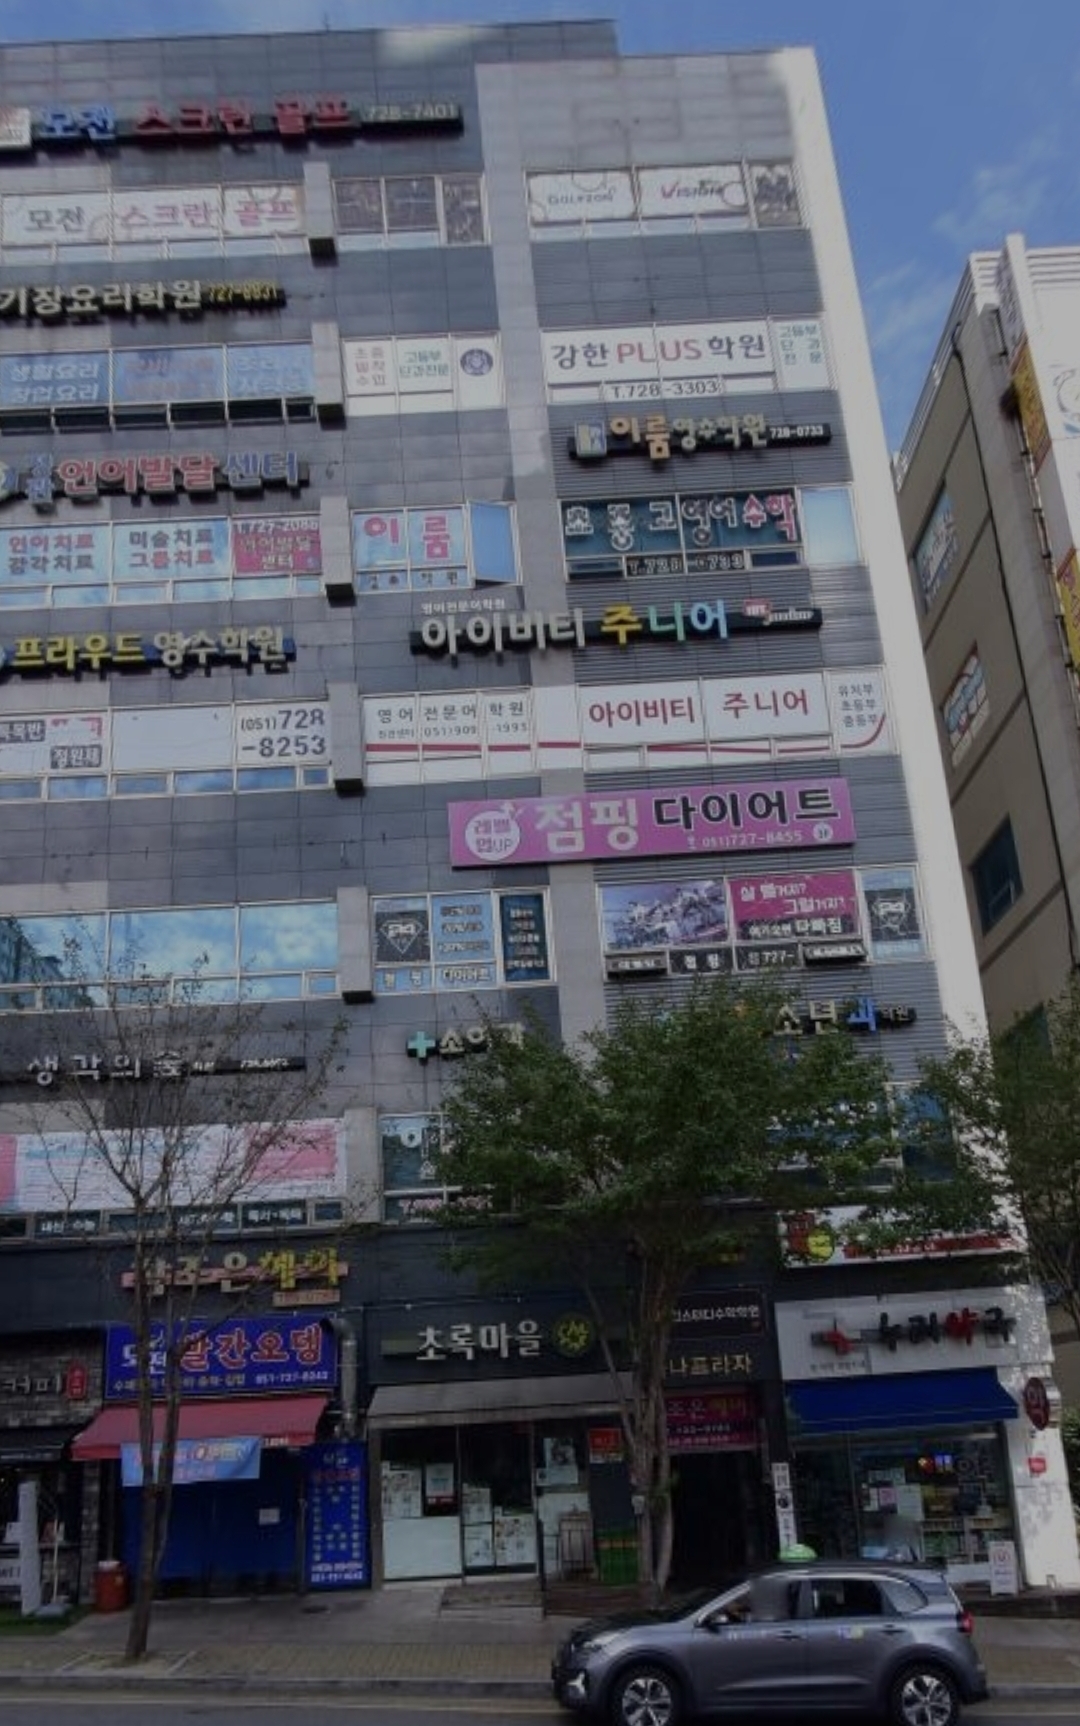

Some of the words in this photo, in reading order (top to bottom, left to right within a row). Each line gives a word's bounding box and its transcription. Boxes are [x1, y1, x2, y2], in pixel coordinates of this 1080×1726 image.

[26, 206, 86, 232] 모전
[117, 202, 216, 229] 스크린
[553, 344, 607, 370] 강한
[617, 339, 702, 363] PLUS
[707, 333, 766, 362] 학원
[610, 415, 670, 459] 이룸
[57, 454, 218, 495] 언어발달
[223, 448, 299, 492] 센터
[743, 493, 799, 542] 수학
[13, 632, 146, 670] 프라우드
[154, 625, 286, 668] 영수학원
[421, 608, 586, 654] 아이비티
[601, 598, 730, 645] 주니어
[589, 695, 696, 728] 아이비티
[723, 688, 809, 719] 주니어
[533, 798, 641, 856] 점핑
[653, 787, 841, 831] 다이어트
[415, 1318, 543, 1361] 초록마을
